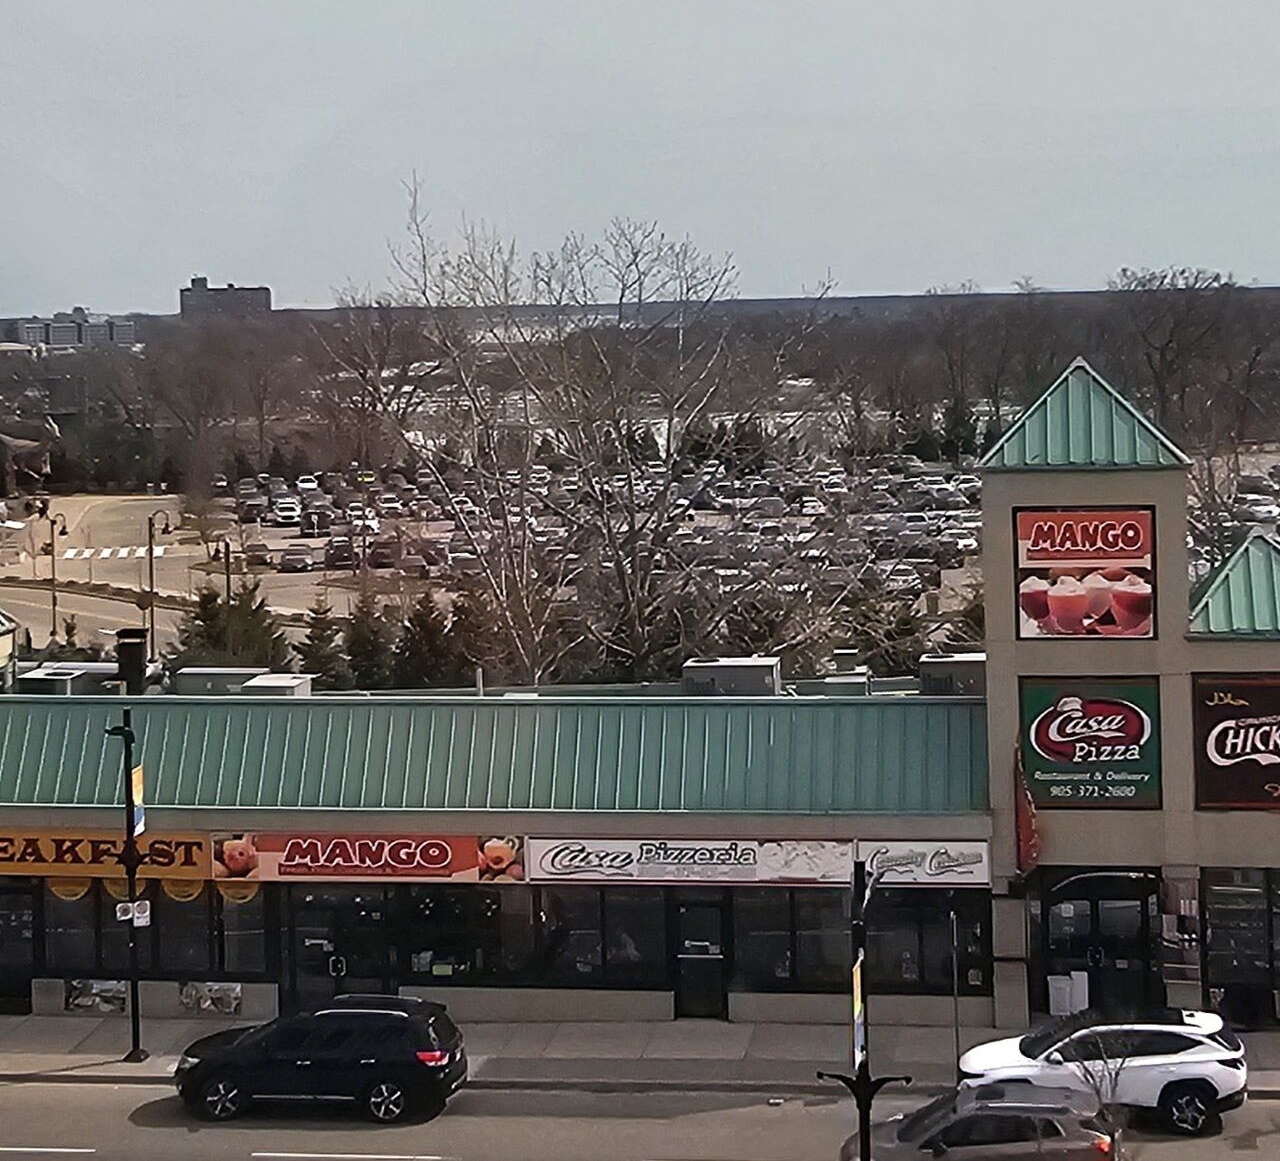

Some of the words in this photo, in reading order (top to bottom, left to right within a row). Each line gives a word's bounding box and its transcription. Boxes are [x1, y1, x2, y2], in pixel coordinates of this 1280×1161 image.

[1029, 521, 1143, 551] MANGO
[1048, 711, 1126, 742] Casa
[1072, 741, 1140, 762] Pizza
[283, 838, 452, 868] MANGO
[539, 842, 635, 877] Casa
[636, 842, 758, 866] Pizzeria
